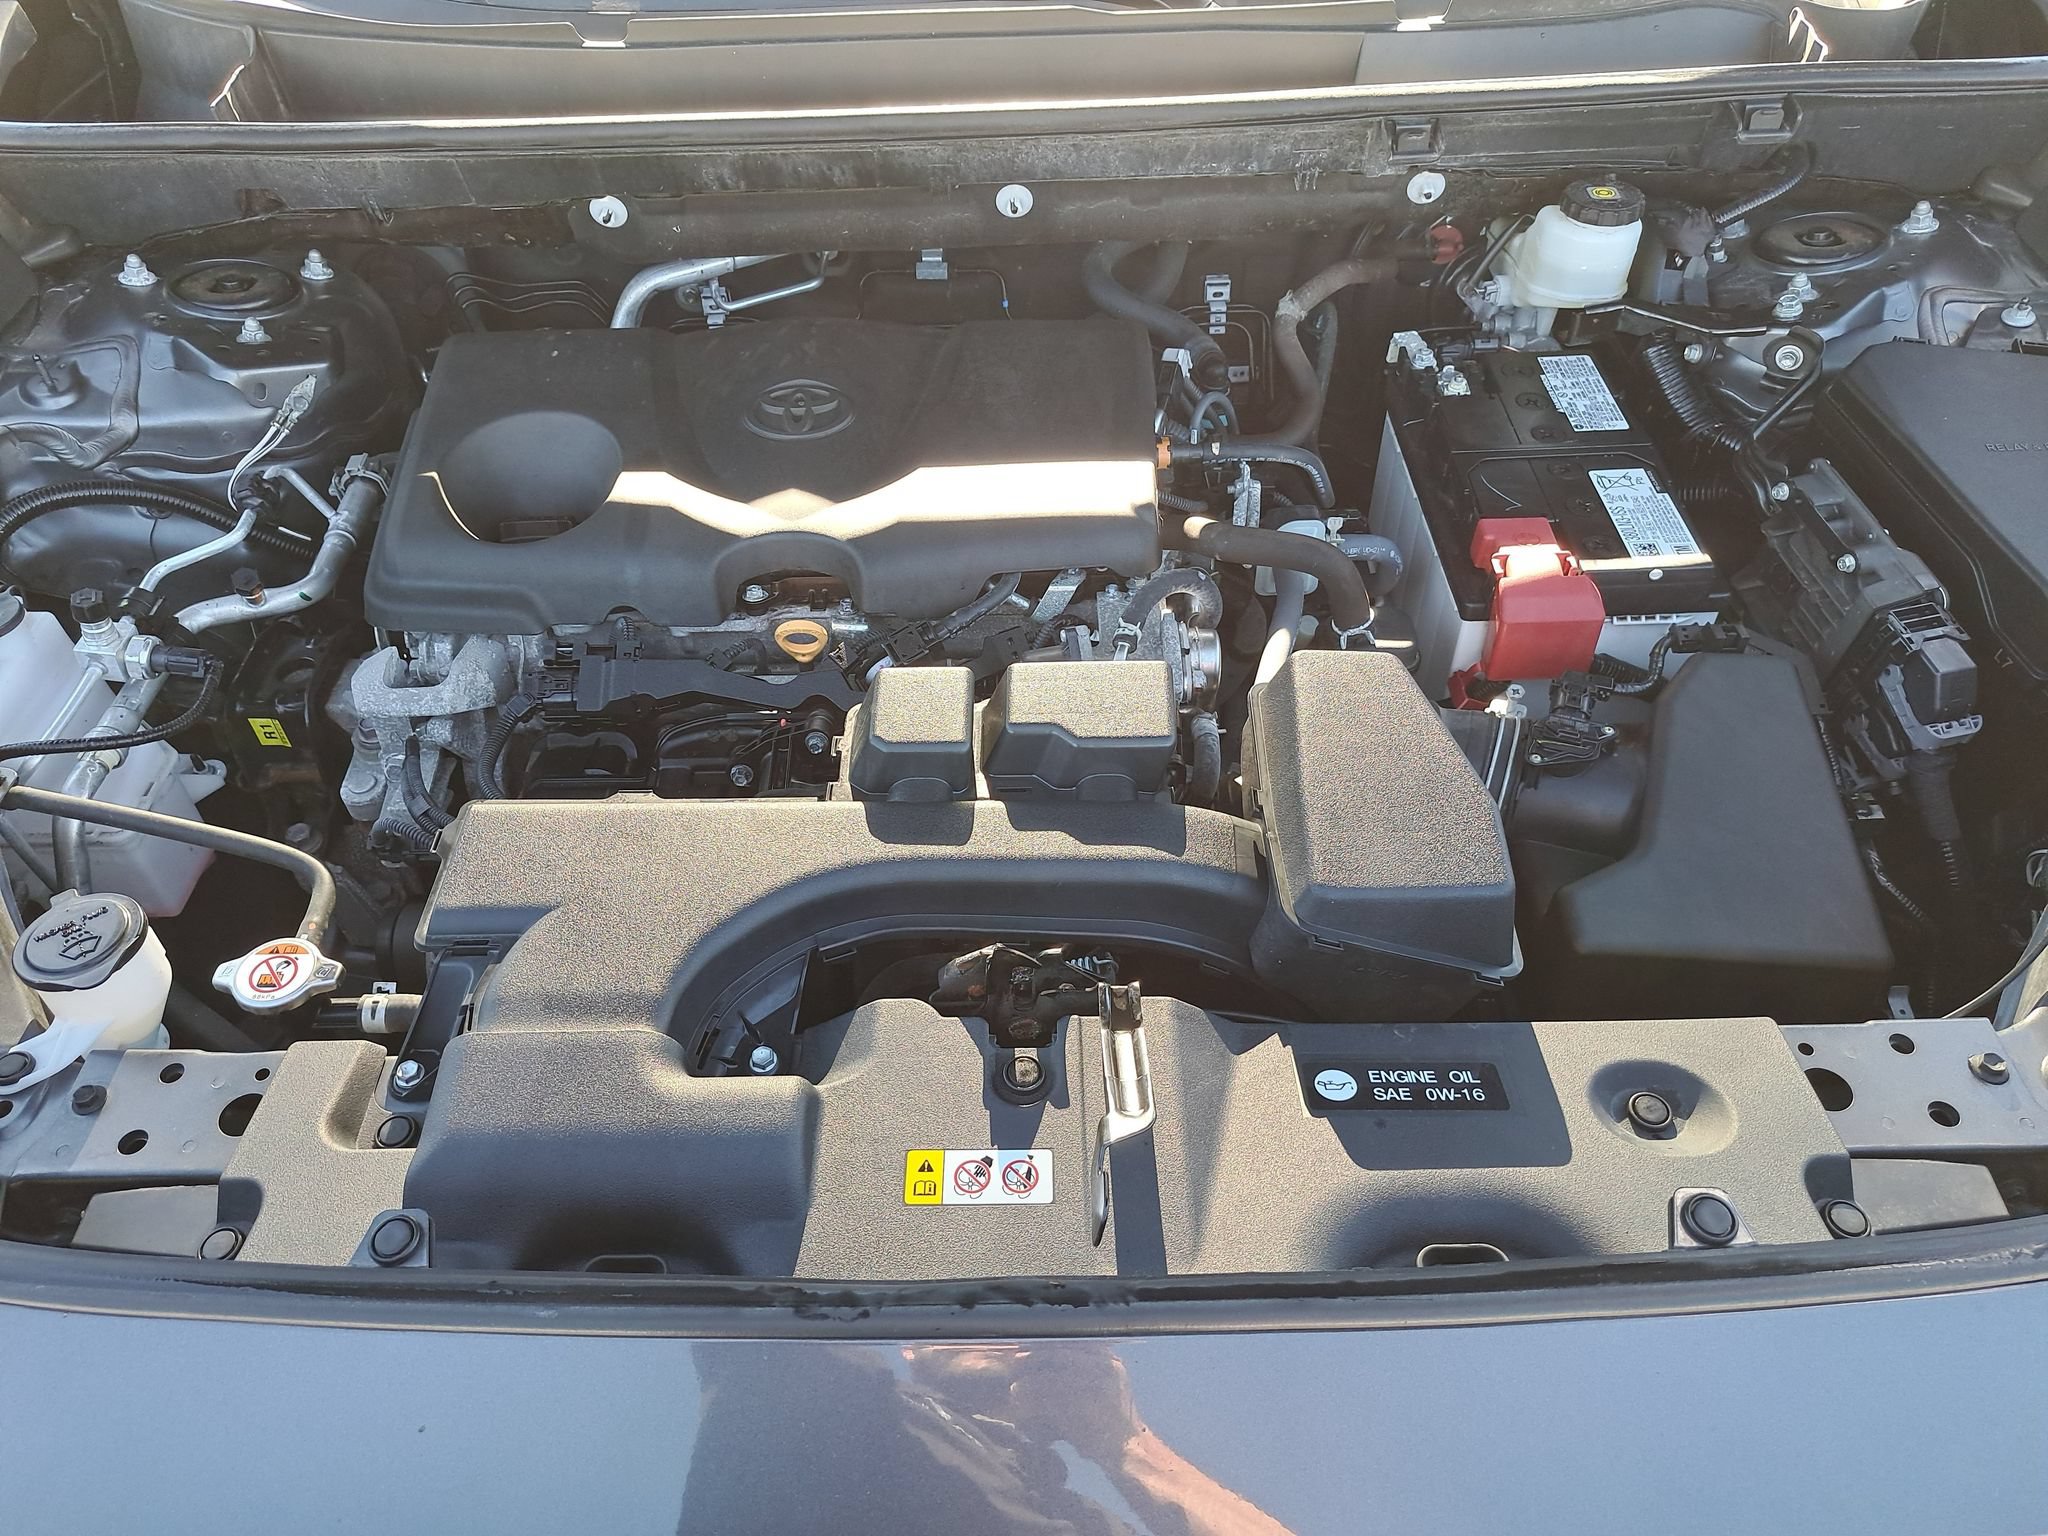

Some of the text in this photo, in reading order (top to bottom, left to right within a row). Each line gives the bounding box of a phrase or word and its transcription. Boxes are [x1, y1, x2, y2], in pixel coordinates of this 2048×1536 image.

[1984, 443, 2029, 452] RELAY
[259, 724, 279, 740] R1
[1367, 1070, 1482, 1084] ENGINE OIL
[1373, 1087, 1486, 1101] SAE 0W-16
